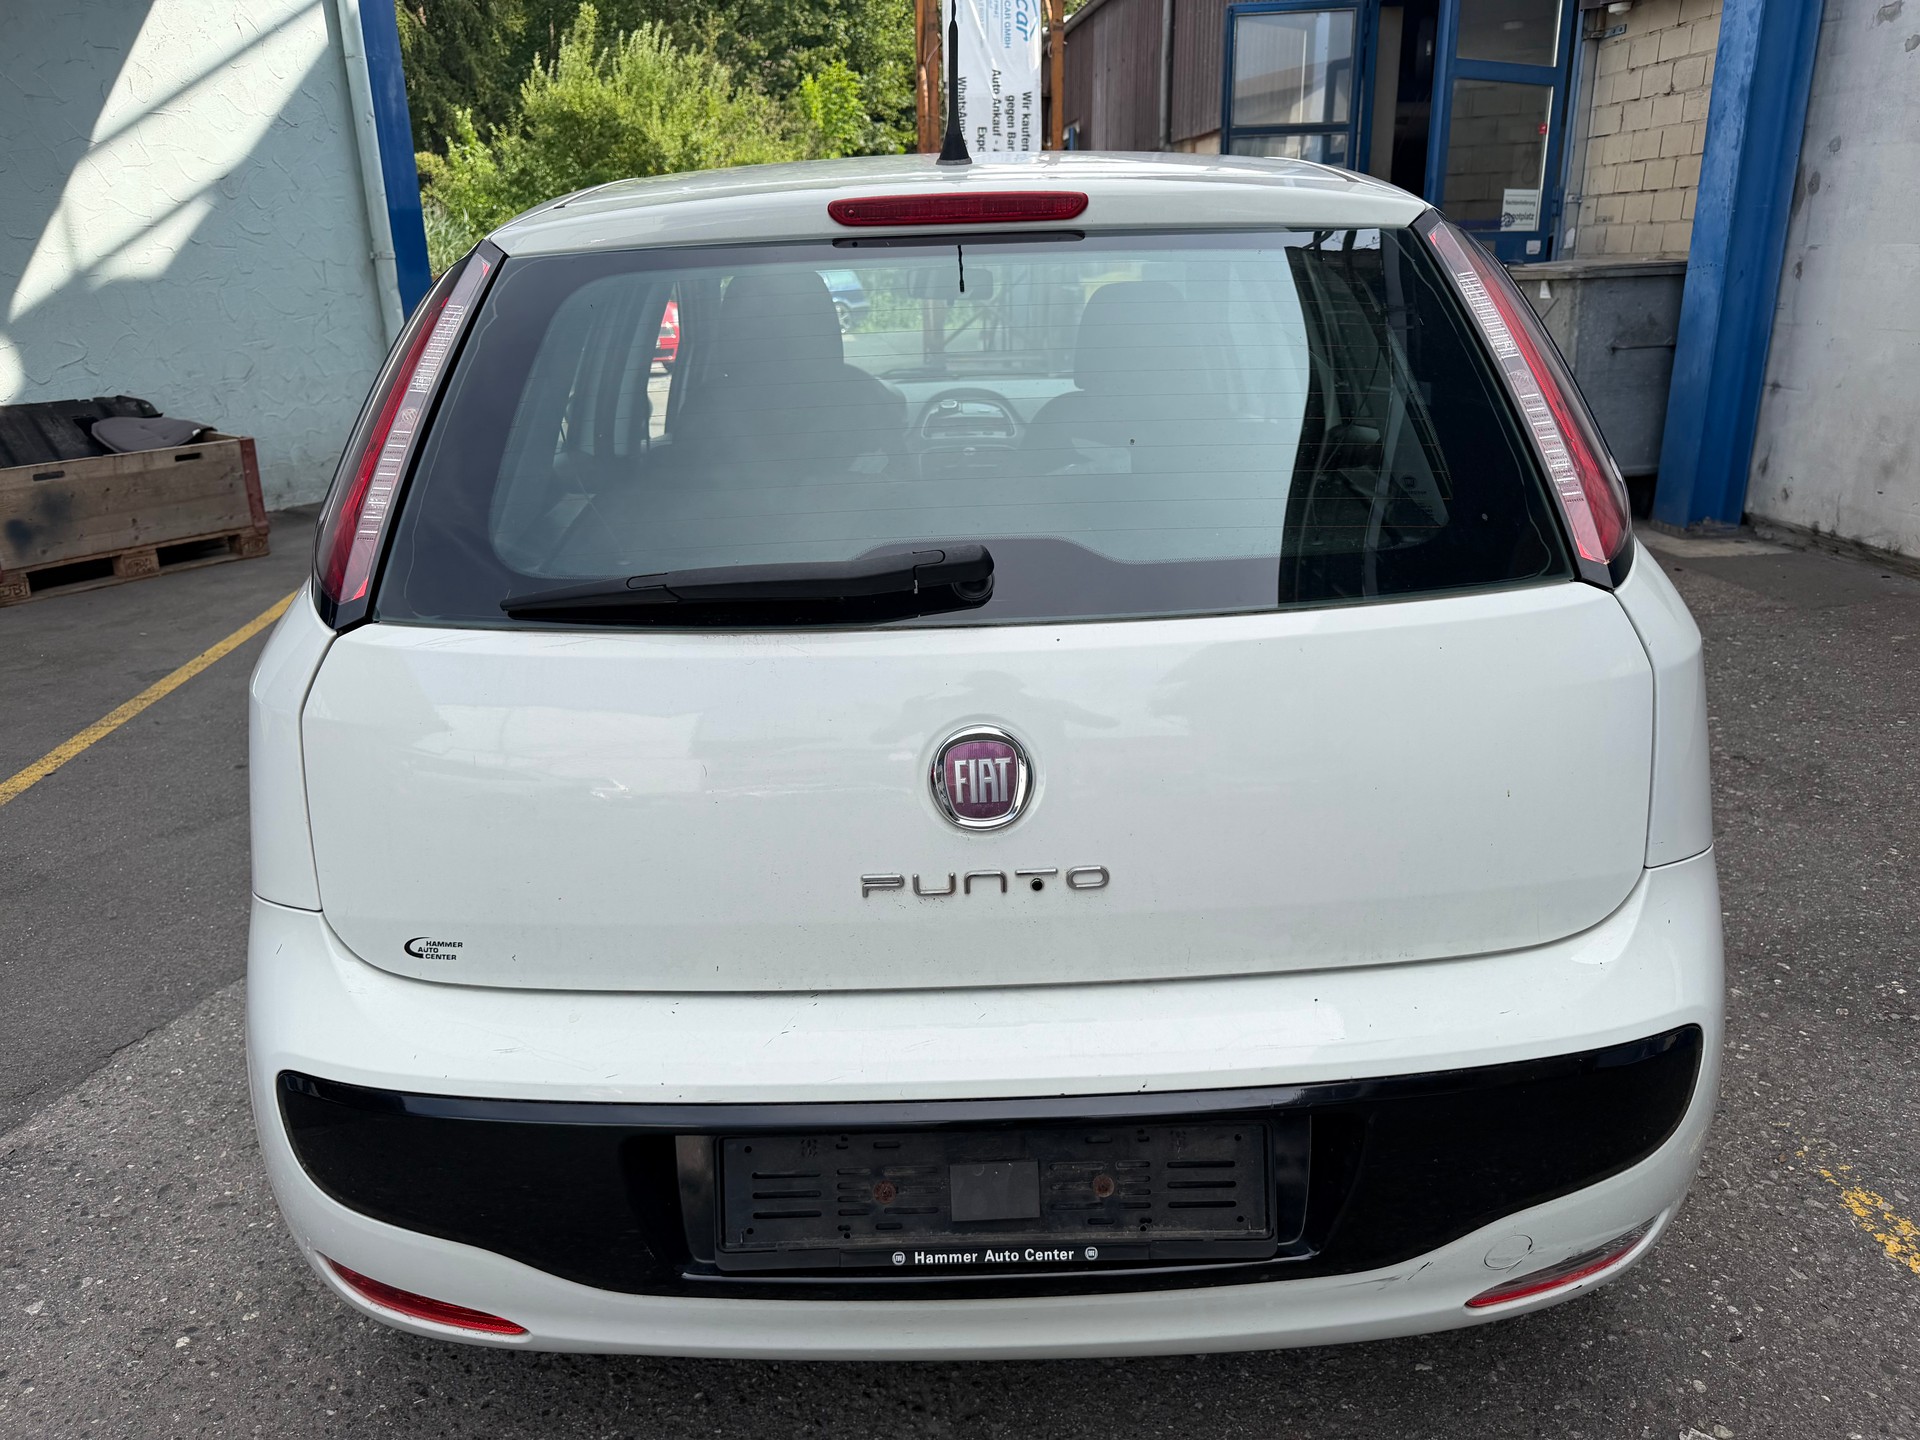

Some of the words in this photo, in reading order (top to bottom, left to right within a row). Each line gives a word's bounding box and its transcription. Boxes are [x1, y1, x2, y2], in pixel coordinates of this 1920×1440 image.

[1004, 21, 1012, 48] GMBH
[992, 69, 1002, 94] Auto
[1005, 95, 1016, 128] gegen
[1022, 91, 1032, 110] Wir
[992, 99, 1002, 136] Ankauf
[1021, 113, 1032, 151] kaufen
[954, 756, 1012, 804] FIAT
[861, 865, 1110, 898] PUNTO
[914, 1251, 978, 1264] Hammer
[984, 1249, 1020, 1262] Auto
[1024, 1248, 1075, 1261] Center
